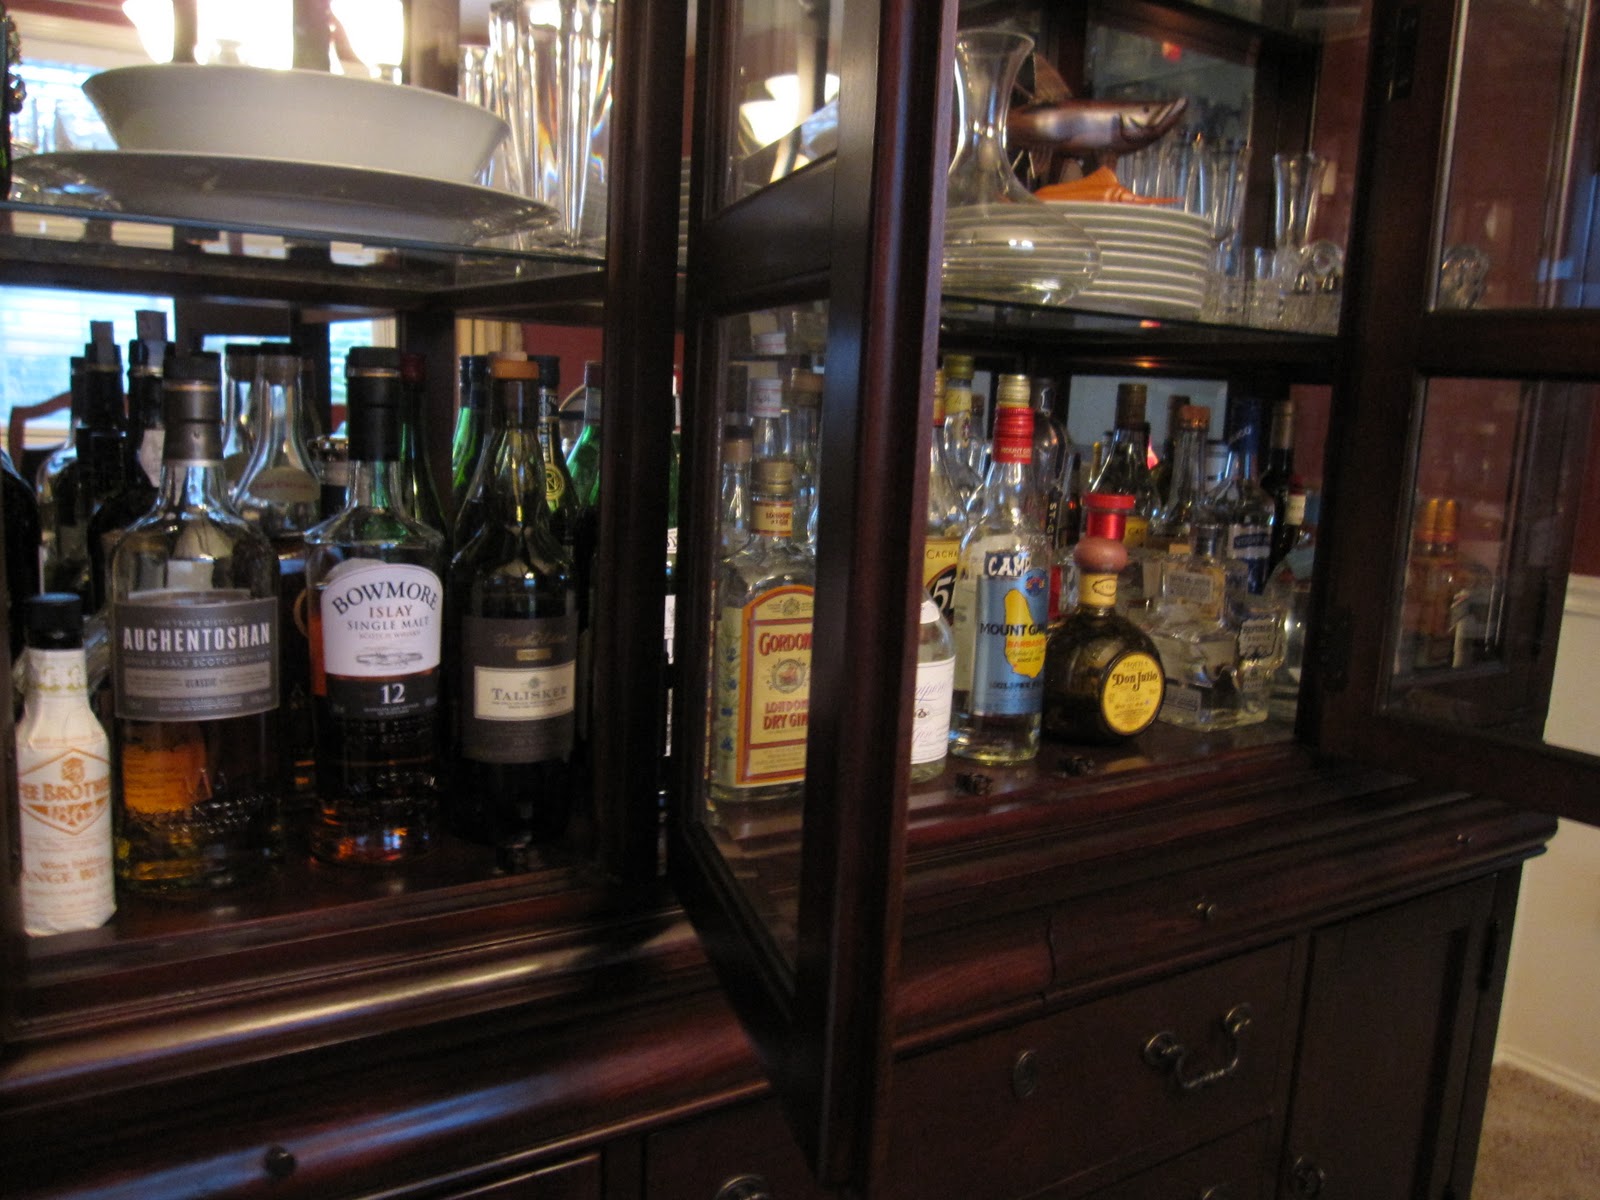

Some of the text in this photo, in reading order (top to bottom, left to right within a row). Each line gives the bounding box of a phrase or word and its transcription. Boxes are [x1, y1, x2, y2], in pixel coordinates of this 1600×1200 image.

[332, 581, 438, 615] BOWMORE
[369, 605, 413, 618] ISLAY
[347, 616, 430, 631] SINGLE MALT
[980, 622, 1026, 637] MOUNT
[123, 622, 270, 652] AUCHENTOSHAN
[759, 632, 812, 656] GORDON
[1112, 672, 1136, 687] Don
[381, 683, 405, 704] 12
[763, 714, 787, 730] DRY
